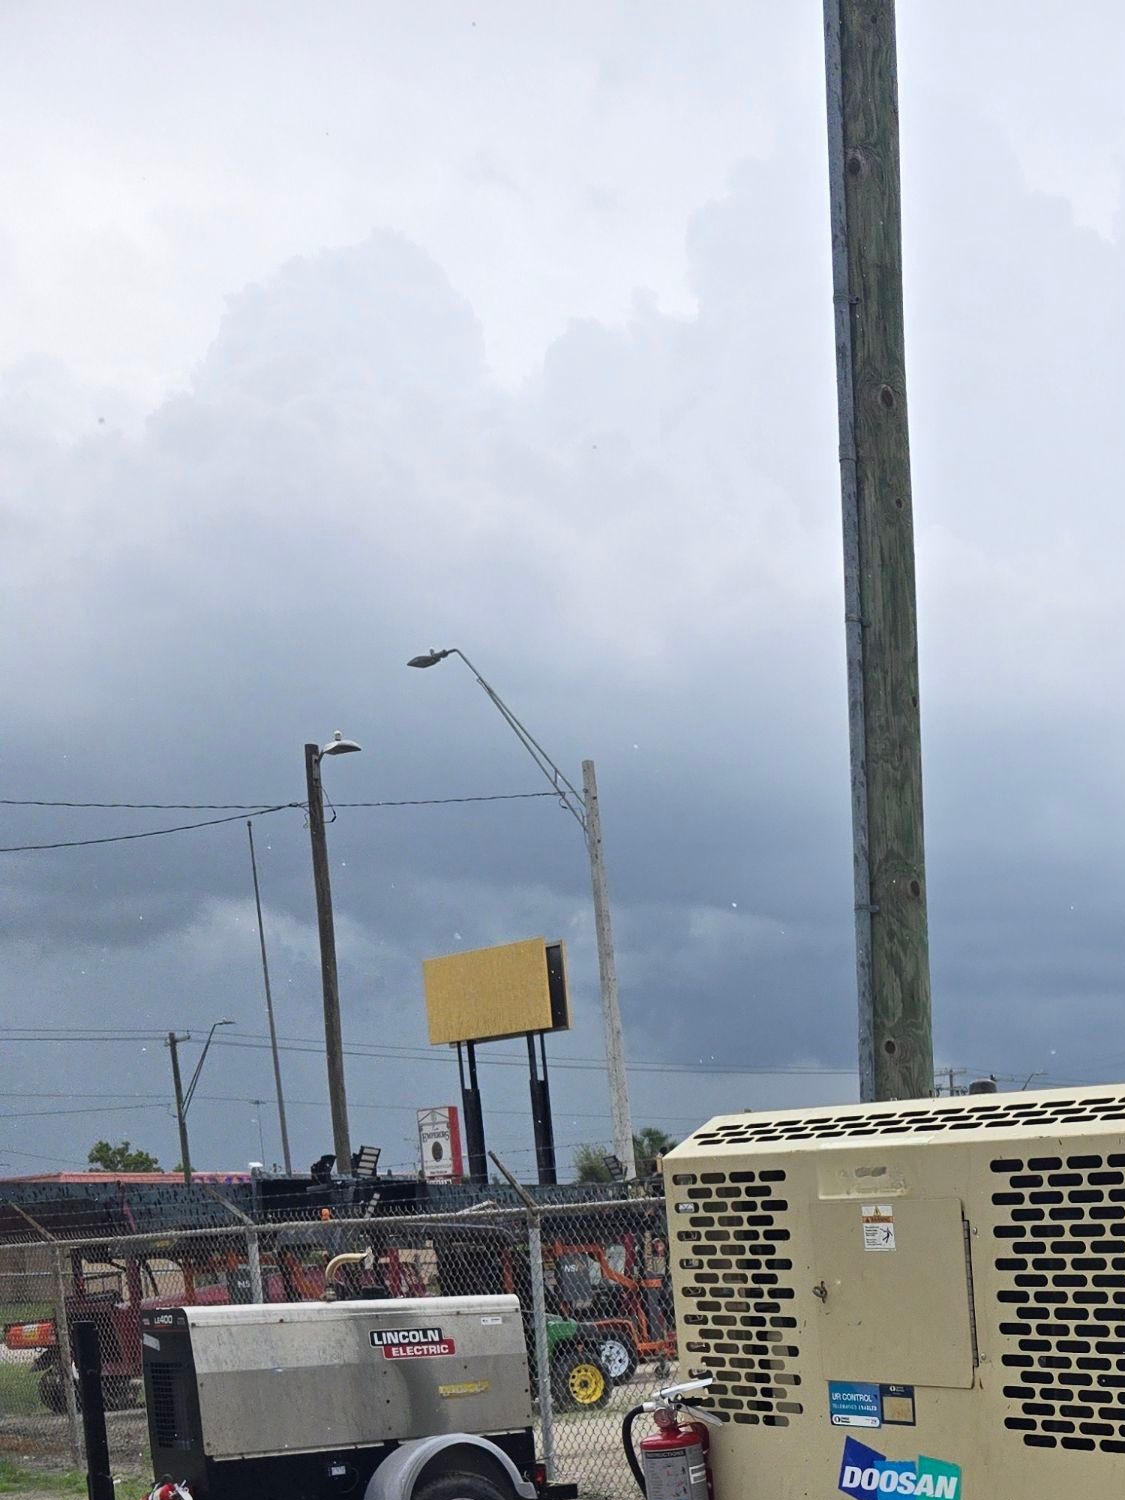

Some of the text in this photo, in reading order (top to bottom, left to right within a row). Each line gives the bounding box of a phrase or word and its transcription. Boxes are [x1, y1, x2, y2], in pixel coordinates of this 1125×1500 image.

[373, 1330, 440, 1345] LINCOLN
[392, 1344, 449, 1357] ELECTRIC
[842, 1393, 872, 1402] CONTROL
[842, 1466, 958, 1500] DOOSAN
